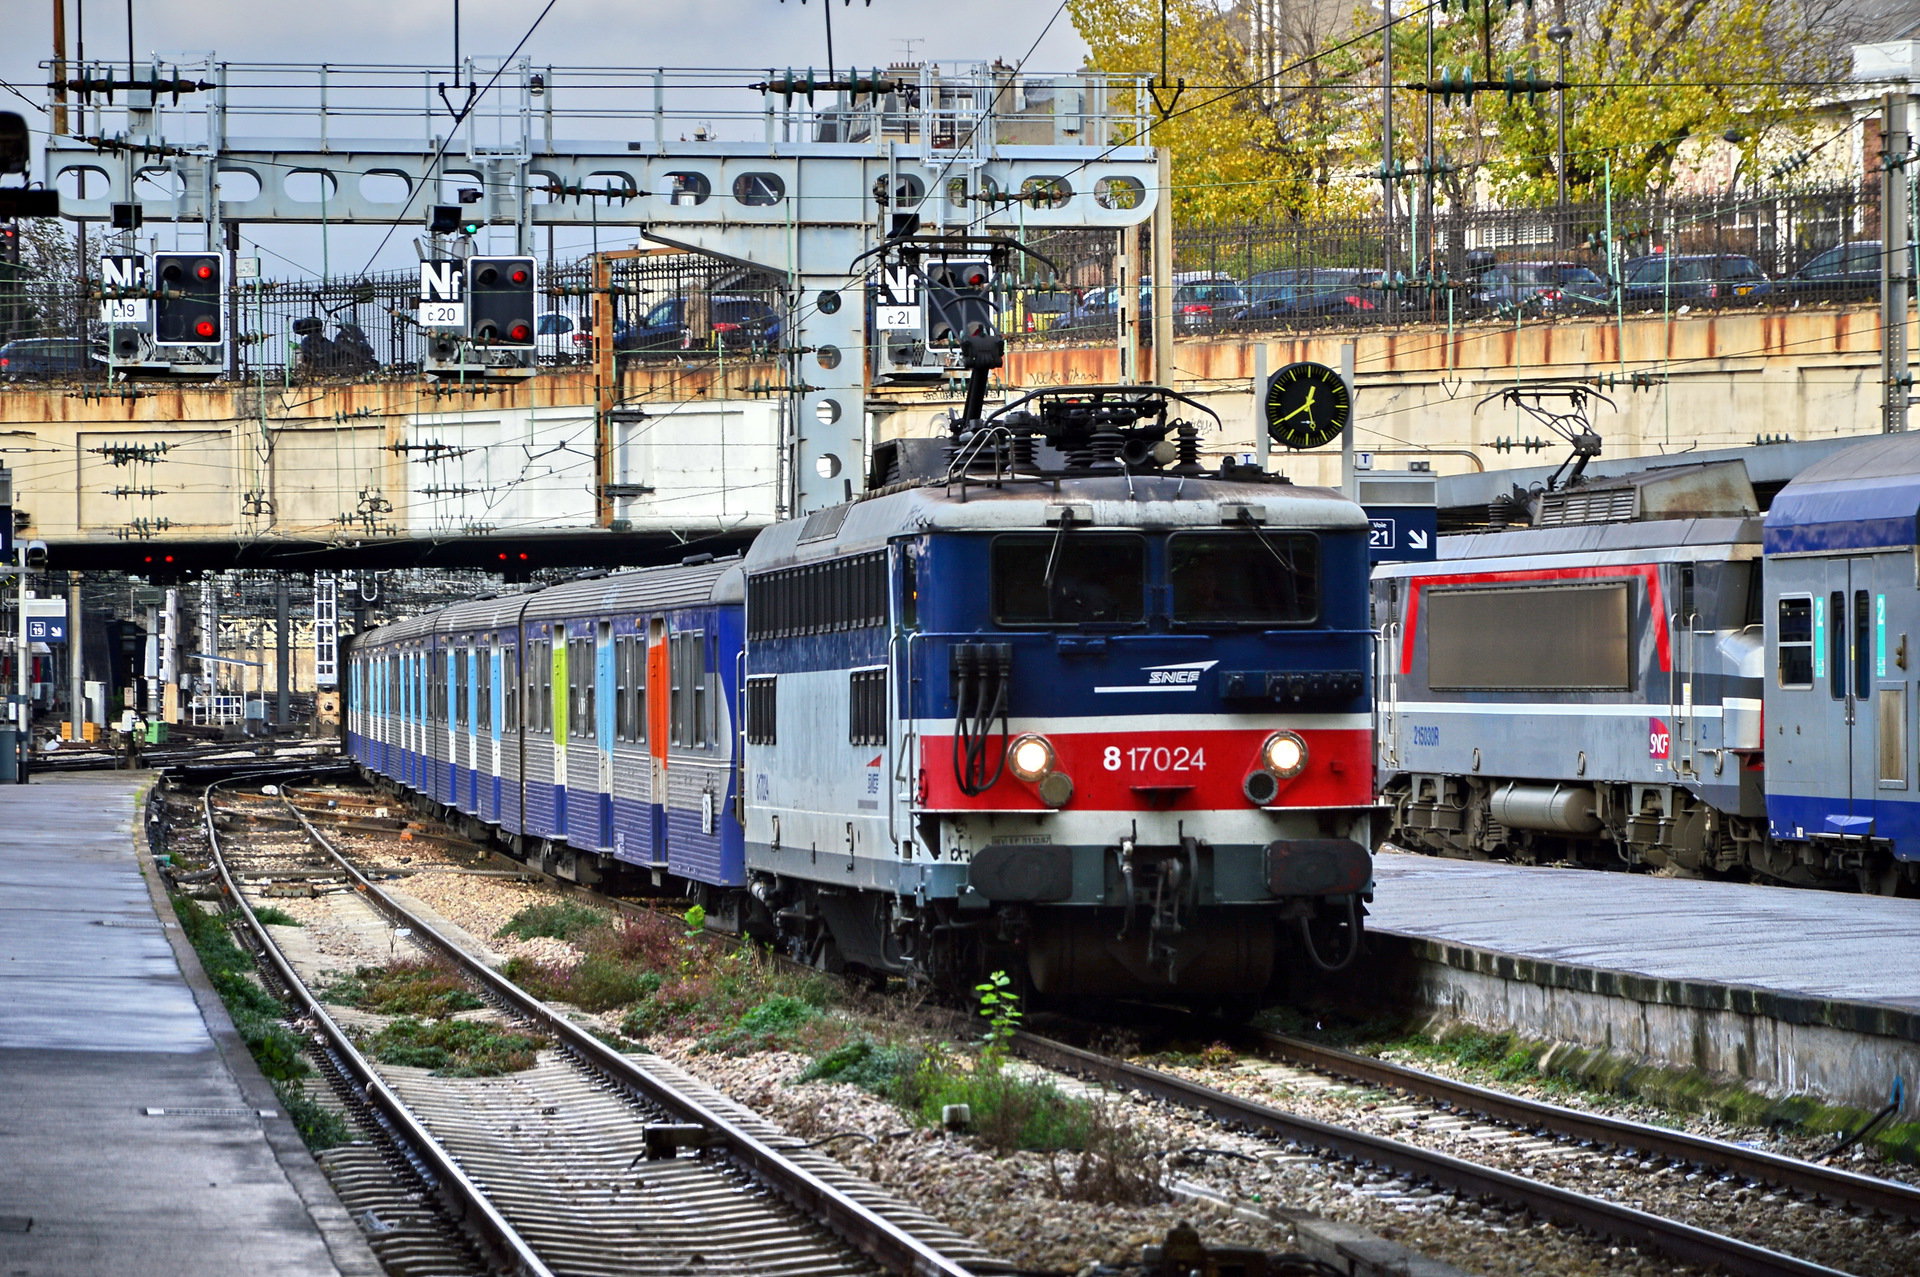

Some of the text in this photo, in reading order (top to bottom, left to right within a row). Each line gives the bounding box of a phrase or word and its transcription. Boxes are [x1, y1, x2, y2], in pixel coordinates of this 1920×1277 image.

[421, 262, 463, 300] Nf
[877, 265, 919, 304] Nf
[427, 308, 456, 322] c.20
[887, 311, 910, 325] c.21
[1361, 454, 1370, 464] T
[1369, 530, 1388, 545] 21
[33, 627, 43, 635] 19
[1148, 671, 1200, 684] SNCF
[1649, 733, 1669, 754] SNCF
